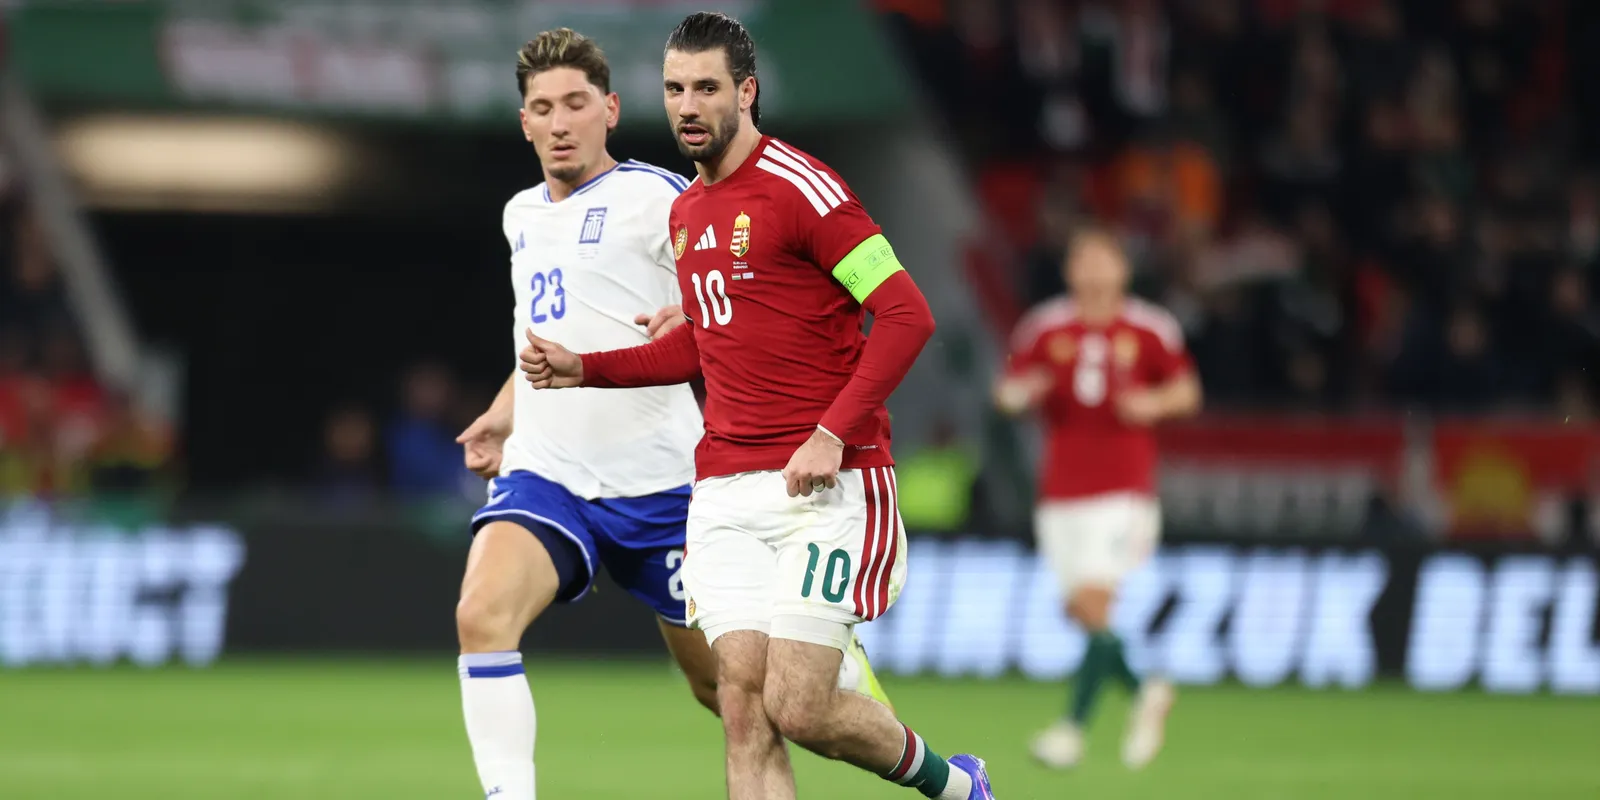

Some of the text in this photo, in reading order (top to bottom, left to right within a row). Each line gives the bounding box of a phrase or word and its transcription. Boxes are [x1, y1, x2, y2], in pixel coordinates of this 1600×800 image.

[531, 267, 566, 324] 23
[691, 269, 732, 329] 10
[801, 542, 851, 603] 10
